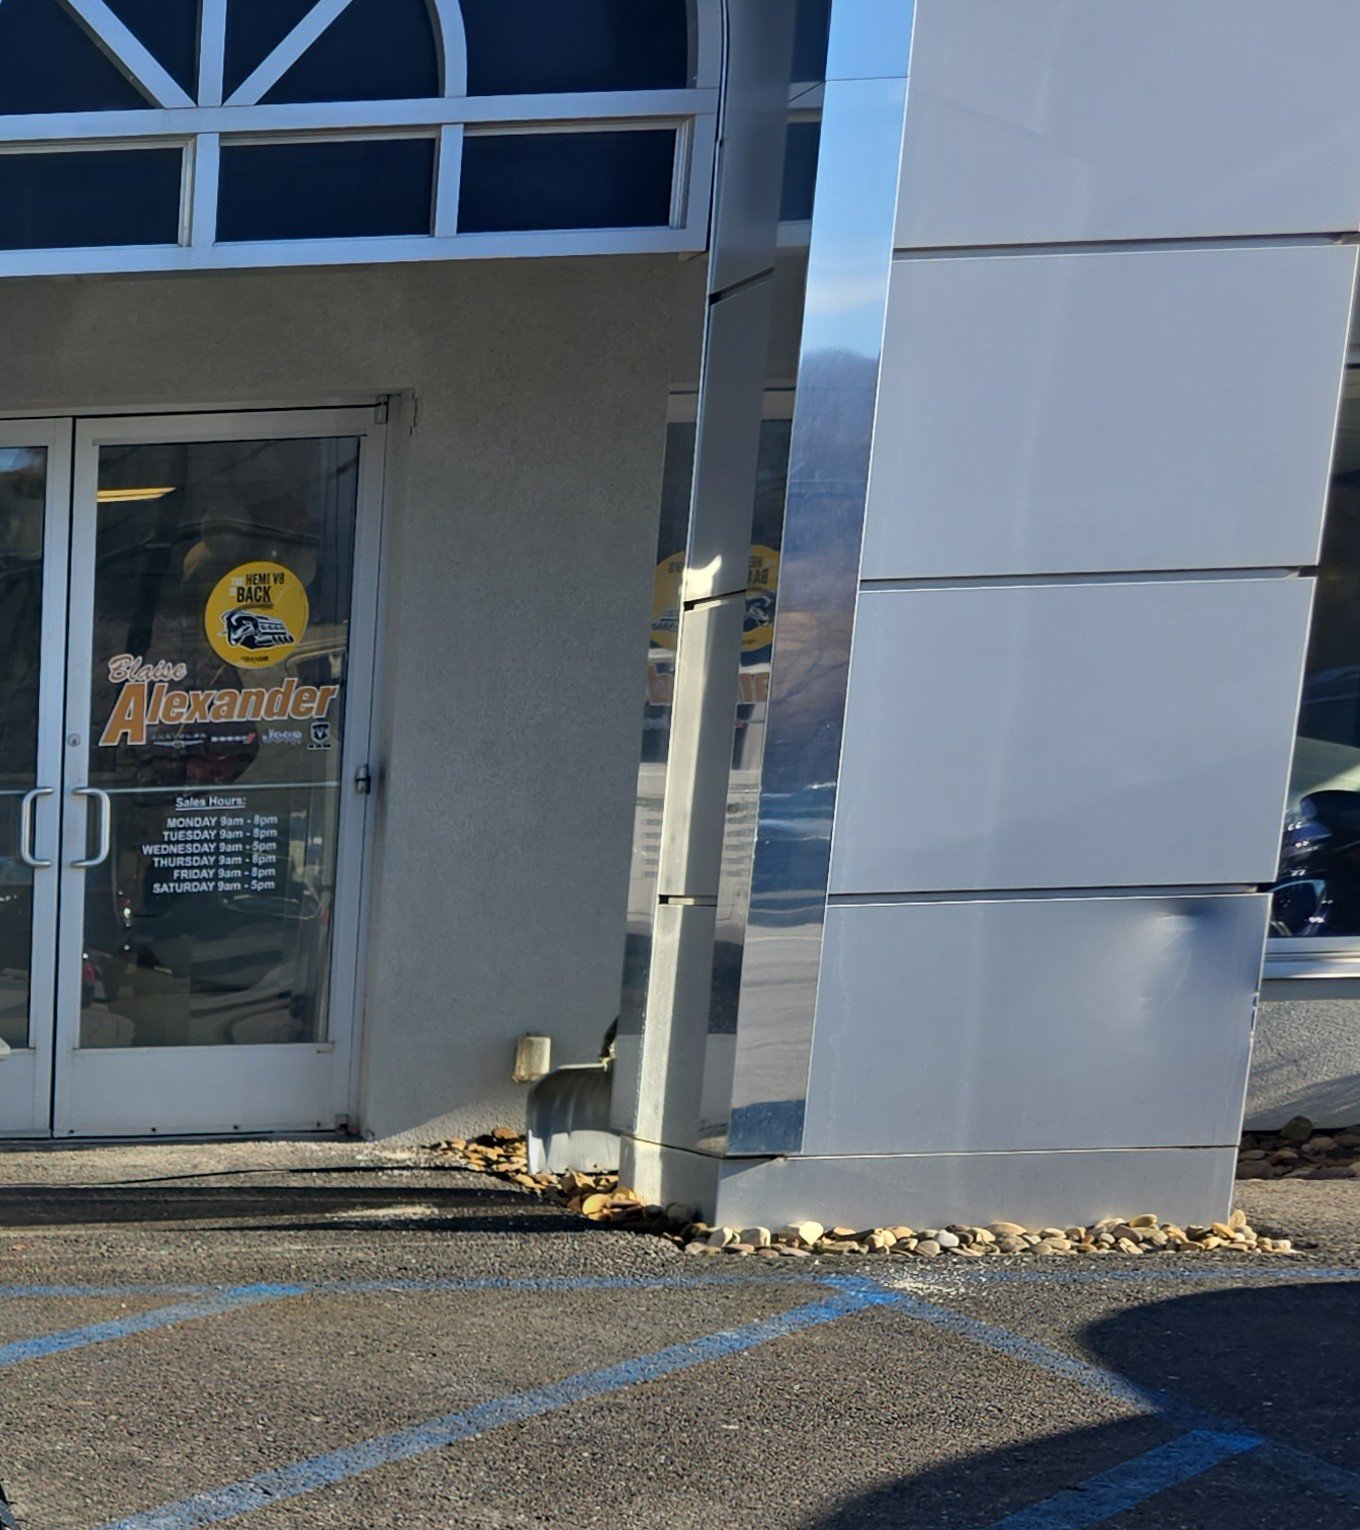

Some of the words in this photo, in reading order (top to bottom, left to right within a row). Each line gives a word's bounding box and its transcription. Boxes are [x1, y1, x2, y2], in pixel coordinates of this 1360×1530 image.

[245, 573, 270, 586] HEMI
[273, 572, 284, 585] V8
[236, 586, 272, 603] BACK
[108, 653, 187, 683] Blaise
[98, 677, 340, 746] Alexander
[175, 797, 206, 808] Sales
[209, 796, 247, 807] Hours:
[167, 817, 217, 828] MONDAY
[220, 816, 243, 826] 9am
[253, 815, 278, 826] 8pm
[162, 830, 217, 841] TUESDAY
[220, 829, 243, 839] 9am
[253, 828, 277, 839] 8pm
[142, 843, 216, 855] WEDNESDAY
[219, 842, 242, 852] 9am
[252, 841, 276, 852] 5pm
[153, 856, 216, 868] THURSDAY
[218, 855, 242, 865] 9am
[173, 869, 215, 880] FRIDAY
[218, 868, 241, 878] 9am
[251, 867, 275, 878] 8pm
[153, 882, 214, 894] SATURDAY
[217, 881, 241, 892] 9am
[251, 880, 275, 891] 5pm
